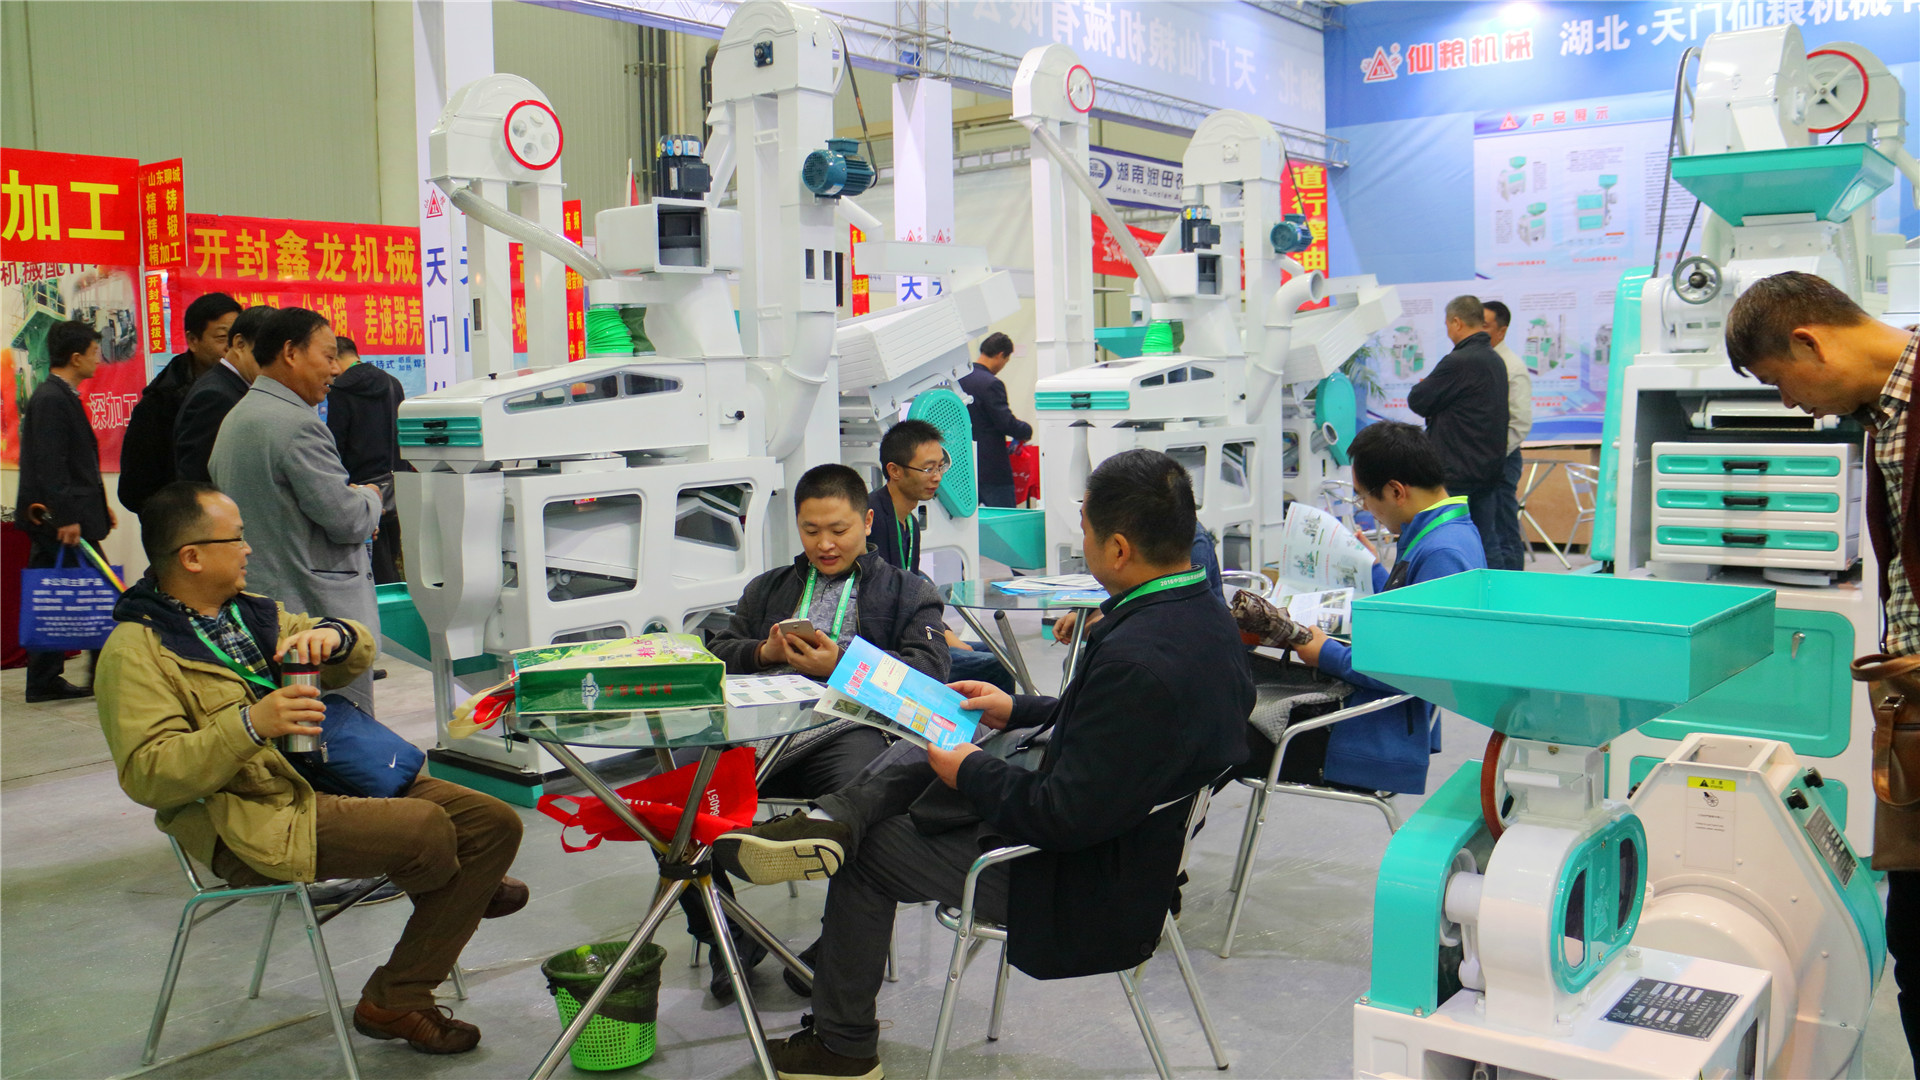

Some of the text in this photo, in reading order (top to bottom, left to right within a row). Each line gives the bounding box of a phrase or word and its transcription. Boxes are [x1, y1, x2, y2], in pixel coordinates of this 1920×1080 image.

[1407, 29, 1534, 74] 仙粮机械
[1531, 106, 1609, 127] 产品展示
[148, 165, 181, 187] 山东聊城
[0, 170, 126, 242] 加工
[148, 241, 182, 266] 精加工
[193, 228, 418, 286] 开封鑫龙机械
[89, 392, 138, 429] 深加工
[706, 788, 720, 817] 64051
